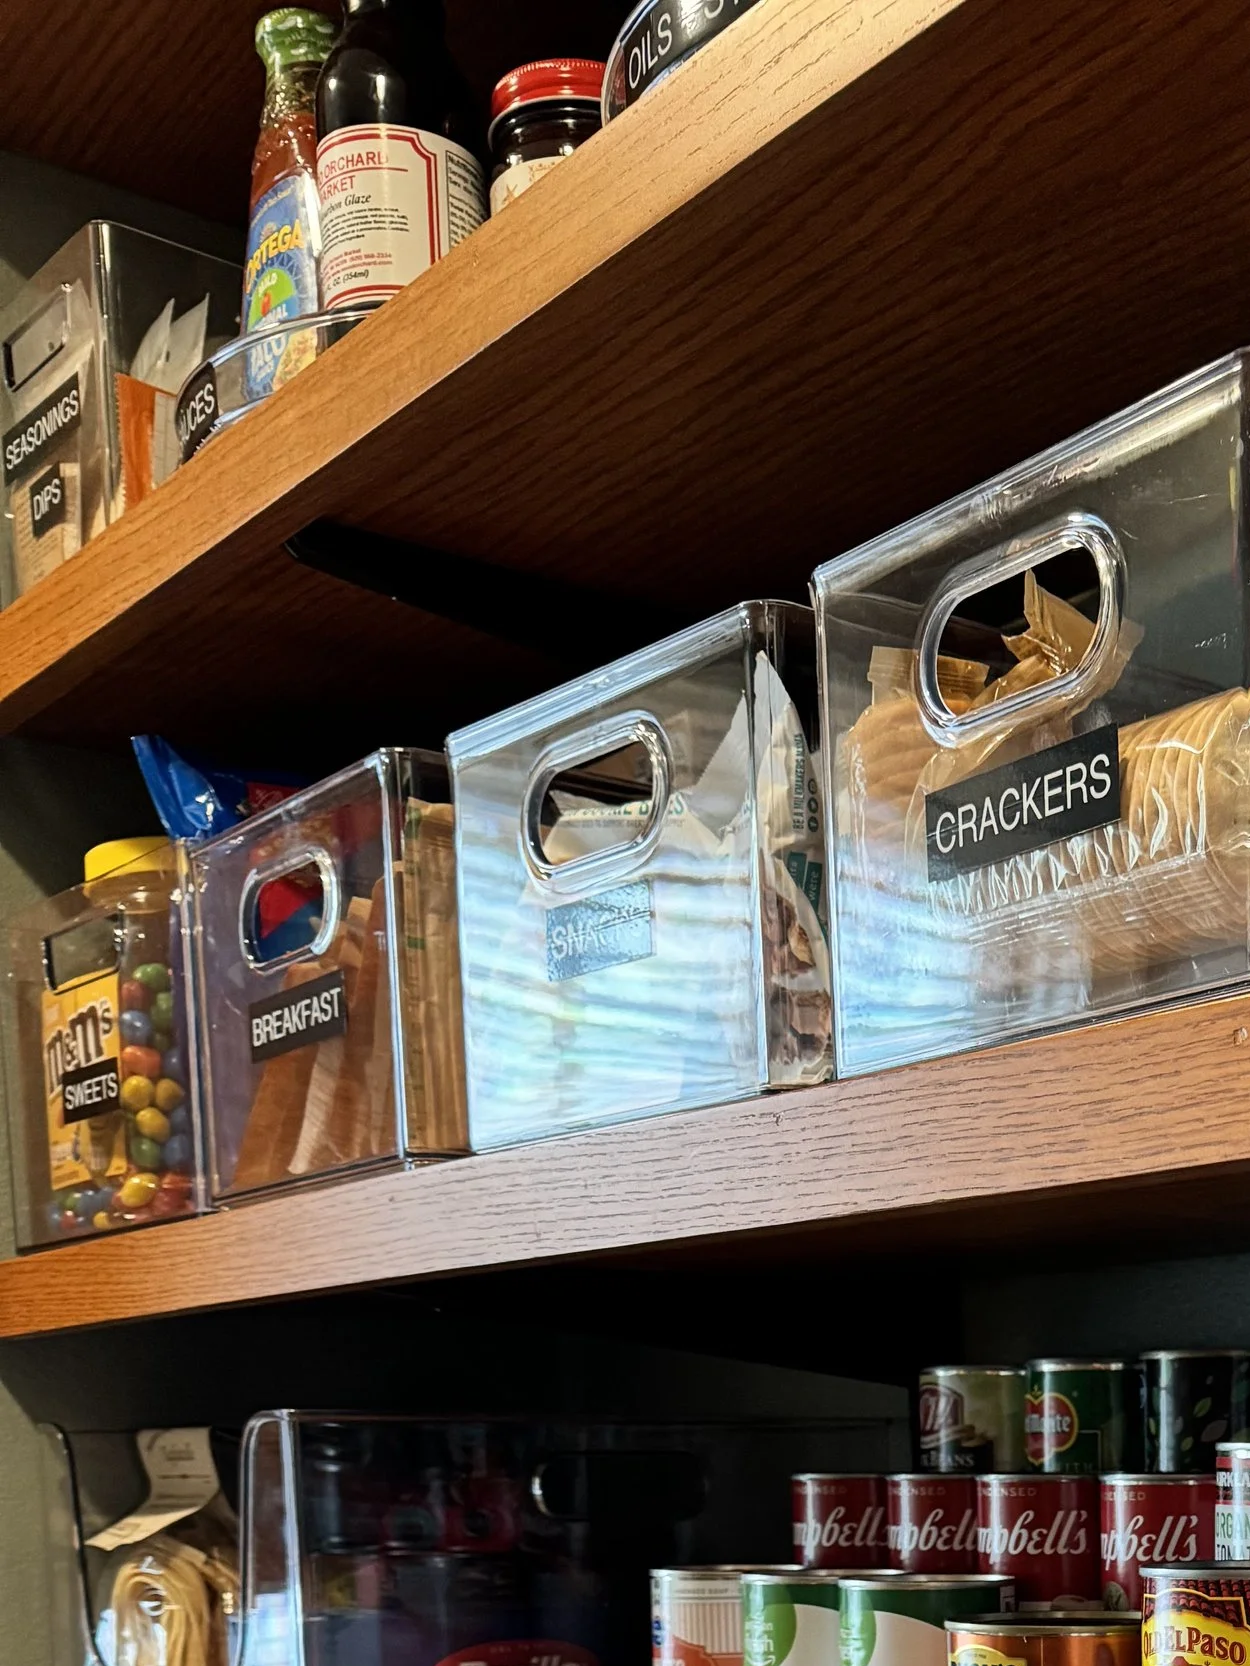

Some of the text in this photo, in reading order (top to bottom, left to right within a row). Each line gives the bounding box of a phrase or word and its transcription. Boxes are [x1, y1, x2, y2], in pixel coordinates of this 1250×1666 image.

[628, 12, 673, 89] OILS
[344, 193, 372, 208] Glaze
[245, 219, 305, 293] ORTEGA
[5, 389, 79, 470] SEASONINGS
[32, 477, 62, 522] DIPS
[934, 751, 1112, 856] CRACKERS
[251, 985, 341, 1048] BREAKFAST
[65, 1071, 119, 1110] SWEETS
[1142, 1628, 1164, 1657] OLD
[1163, 1626, 1187, 1655] EL
